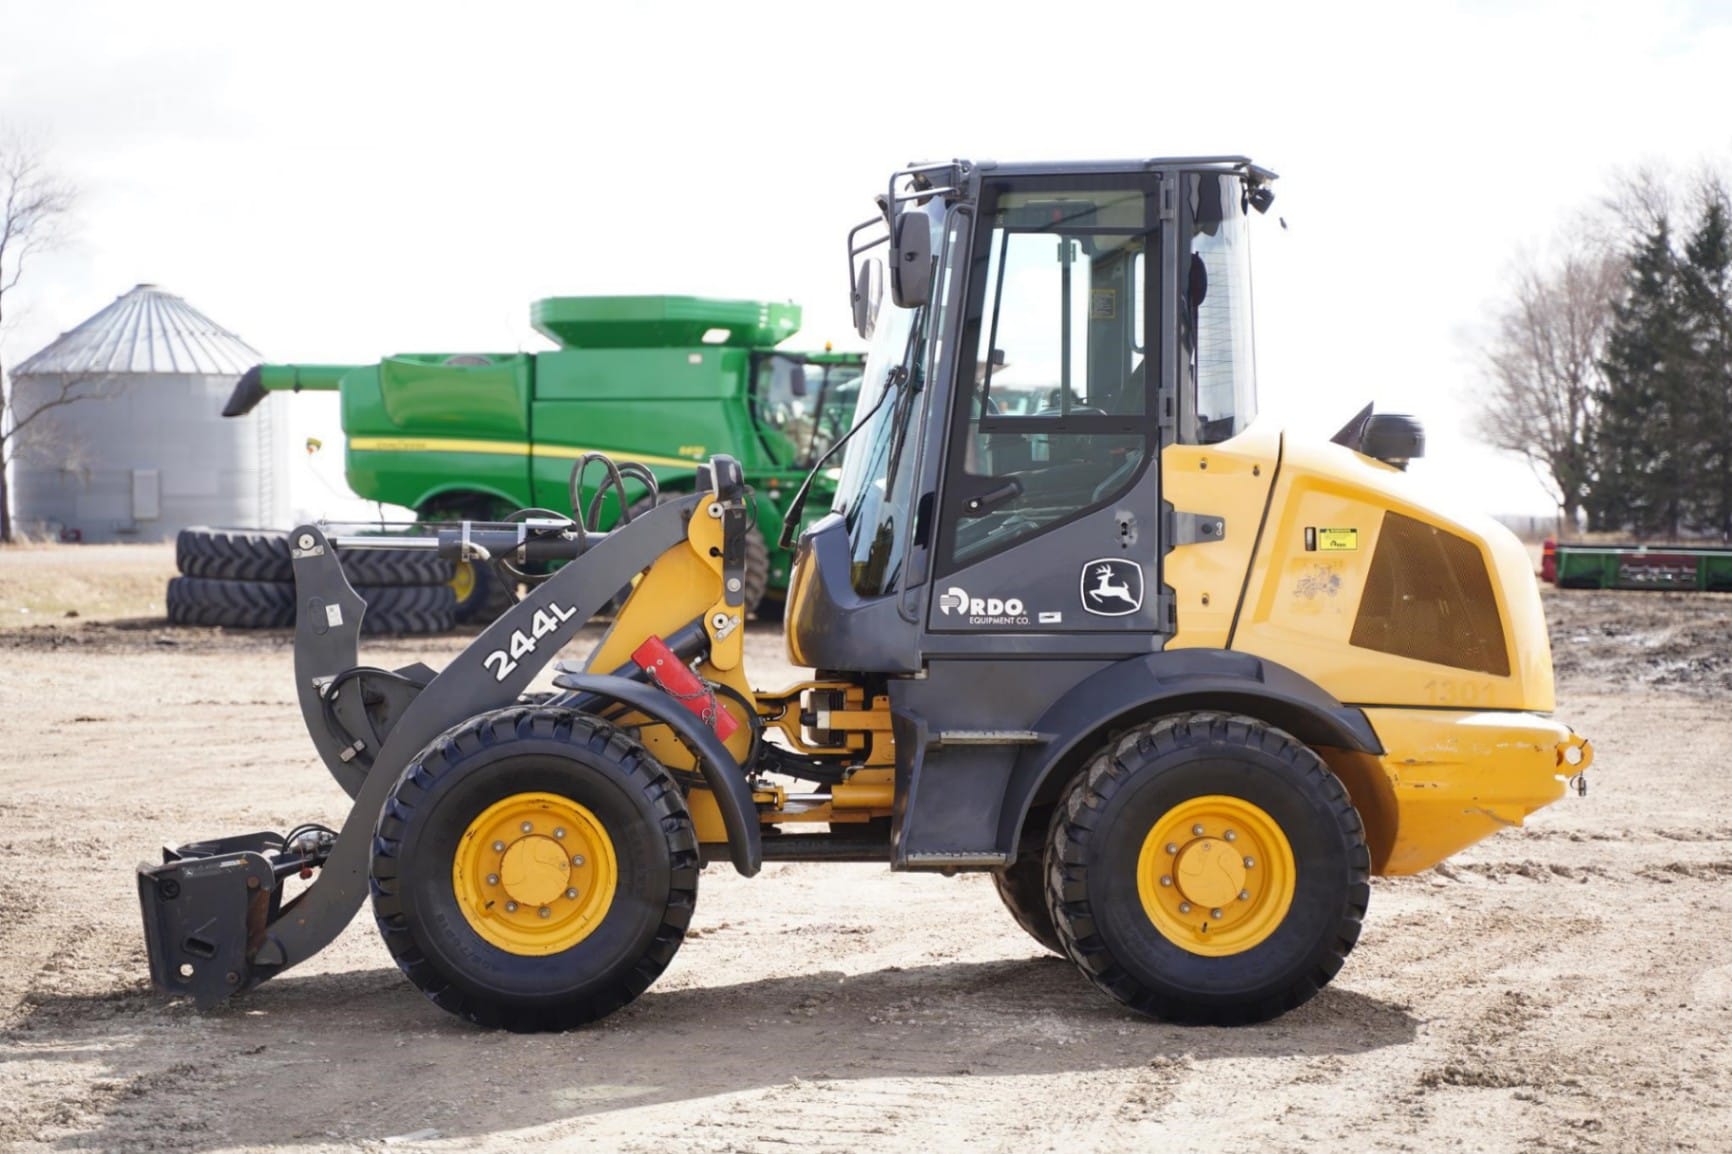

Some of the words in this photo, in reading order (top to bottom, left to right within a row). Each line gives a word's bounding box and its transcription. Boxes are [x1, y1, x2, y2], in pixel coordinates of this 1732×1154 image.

[483, 602, 577, 682] 244L
[969, 616, 1015, 625] EQUIPMENT
[1016, 616, 1031, 625] CO.
